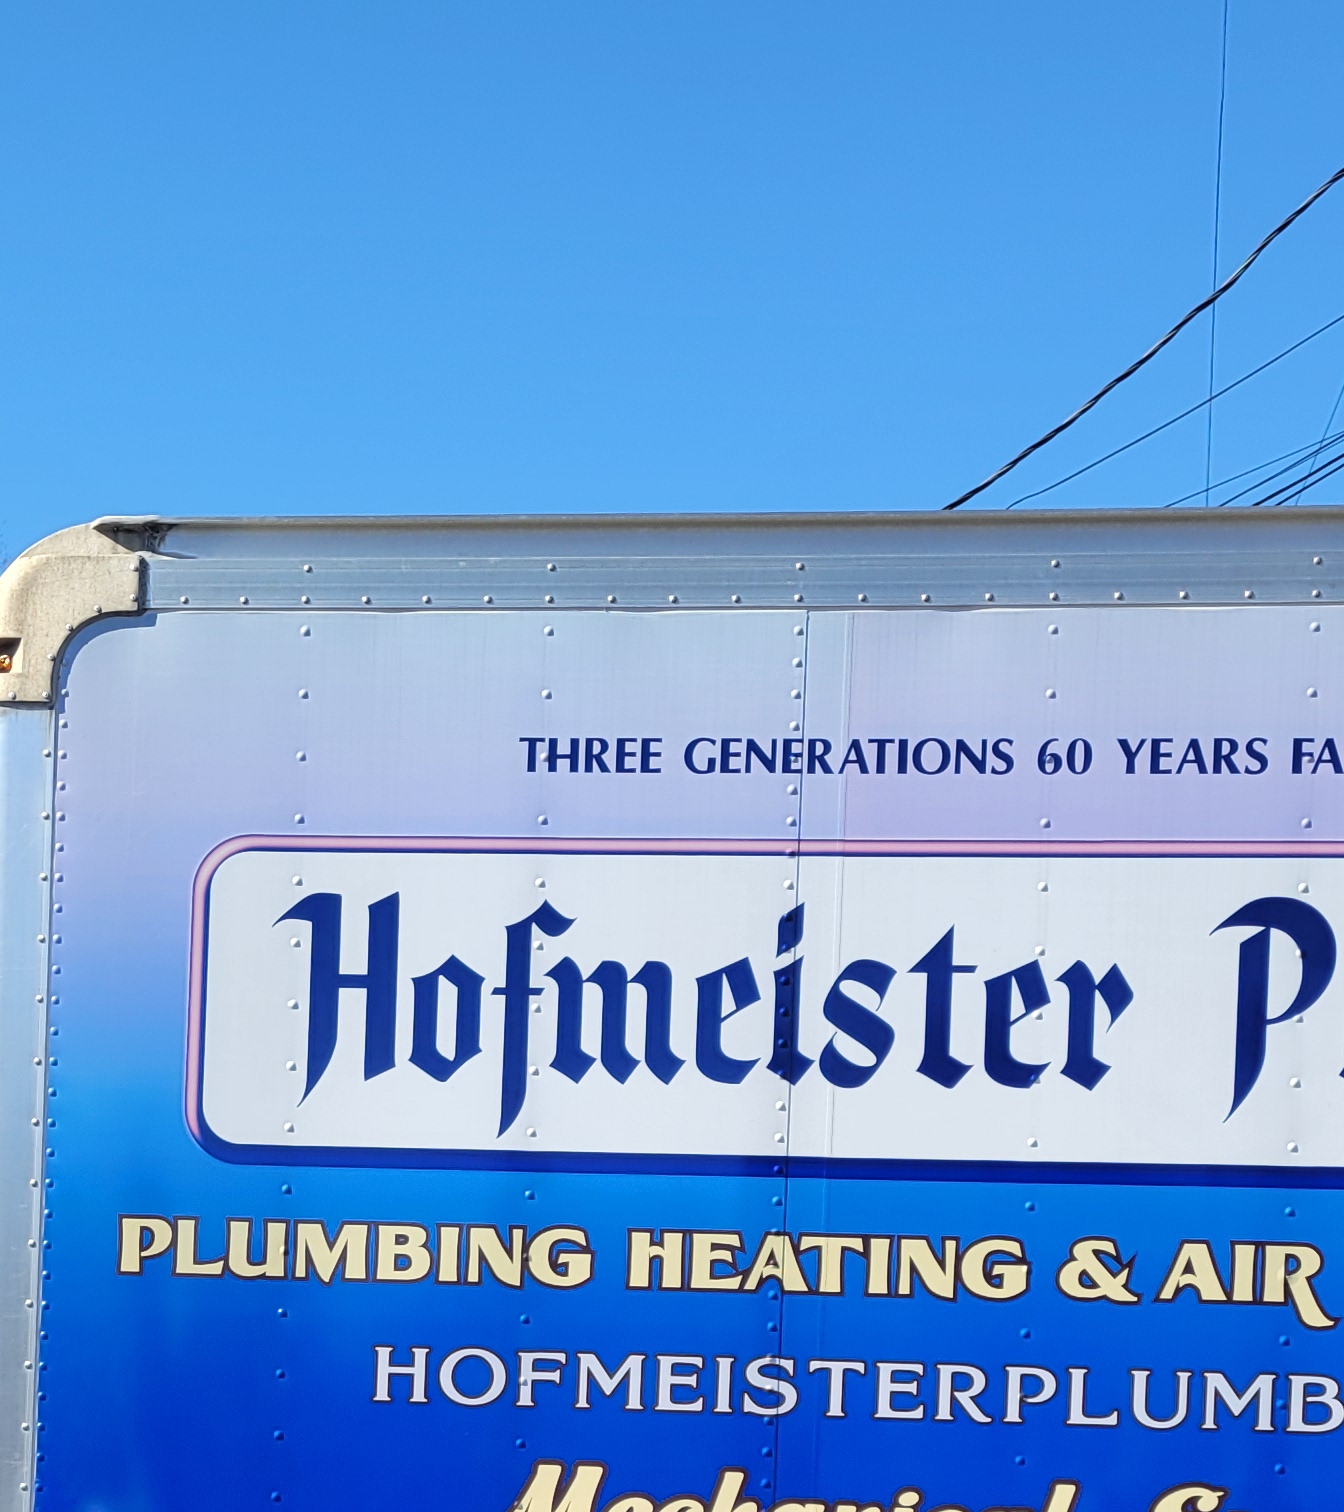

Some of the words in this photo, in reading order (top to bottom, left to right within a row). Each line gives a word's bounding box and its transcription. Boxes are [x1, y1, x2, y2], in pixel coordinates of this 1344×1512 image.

[519, 736, 663, 776] THREE
[682, 736, 1015, 777] GENERATIONS
[1036, 735, 1093, 777] 60
[1117, 736, 1269, 776] YEARS
[272, 890, 1135, 1139] Hofmeister
[116, 1214, 595, 1288] PLUMBING
[626, 1228, 1030, 1301] HEATING
[1058, 1235, 1139, 1305] &
[1155, 1239, 1340, 1330] AIR
